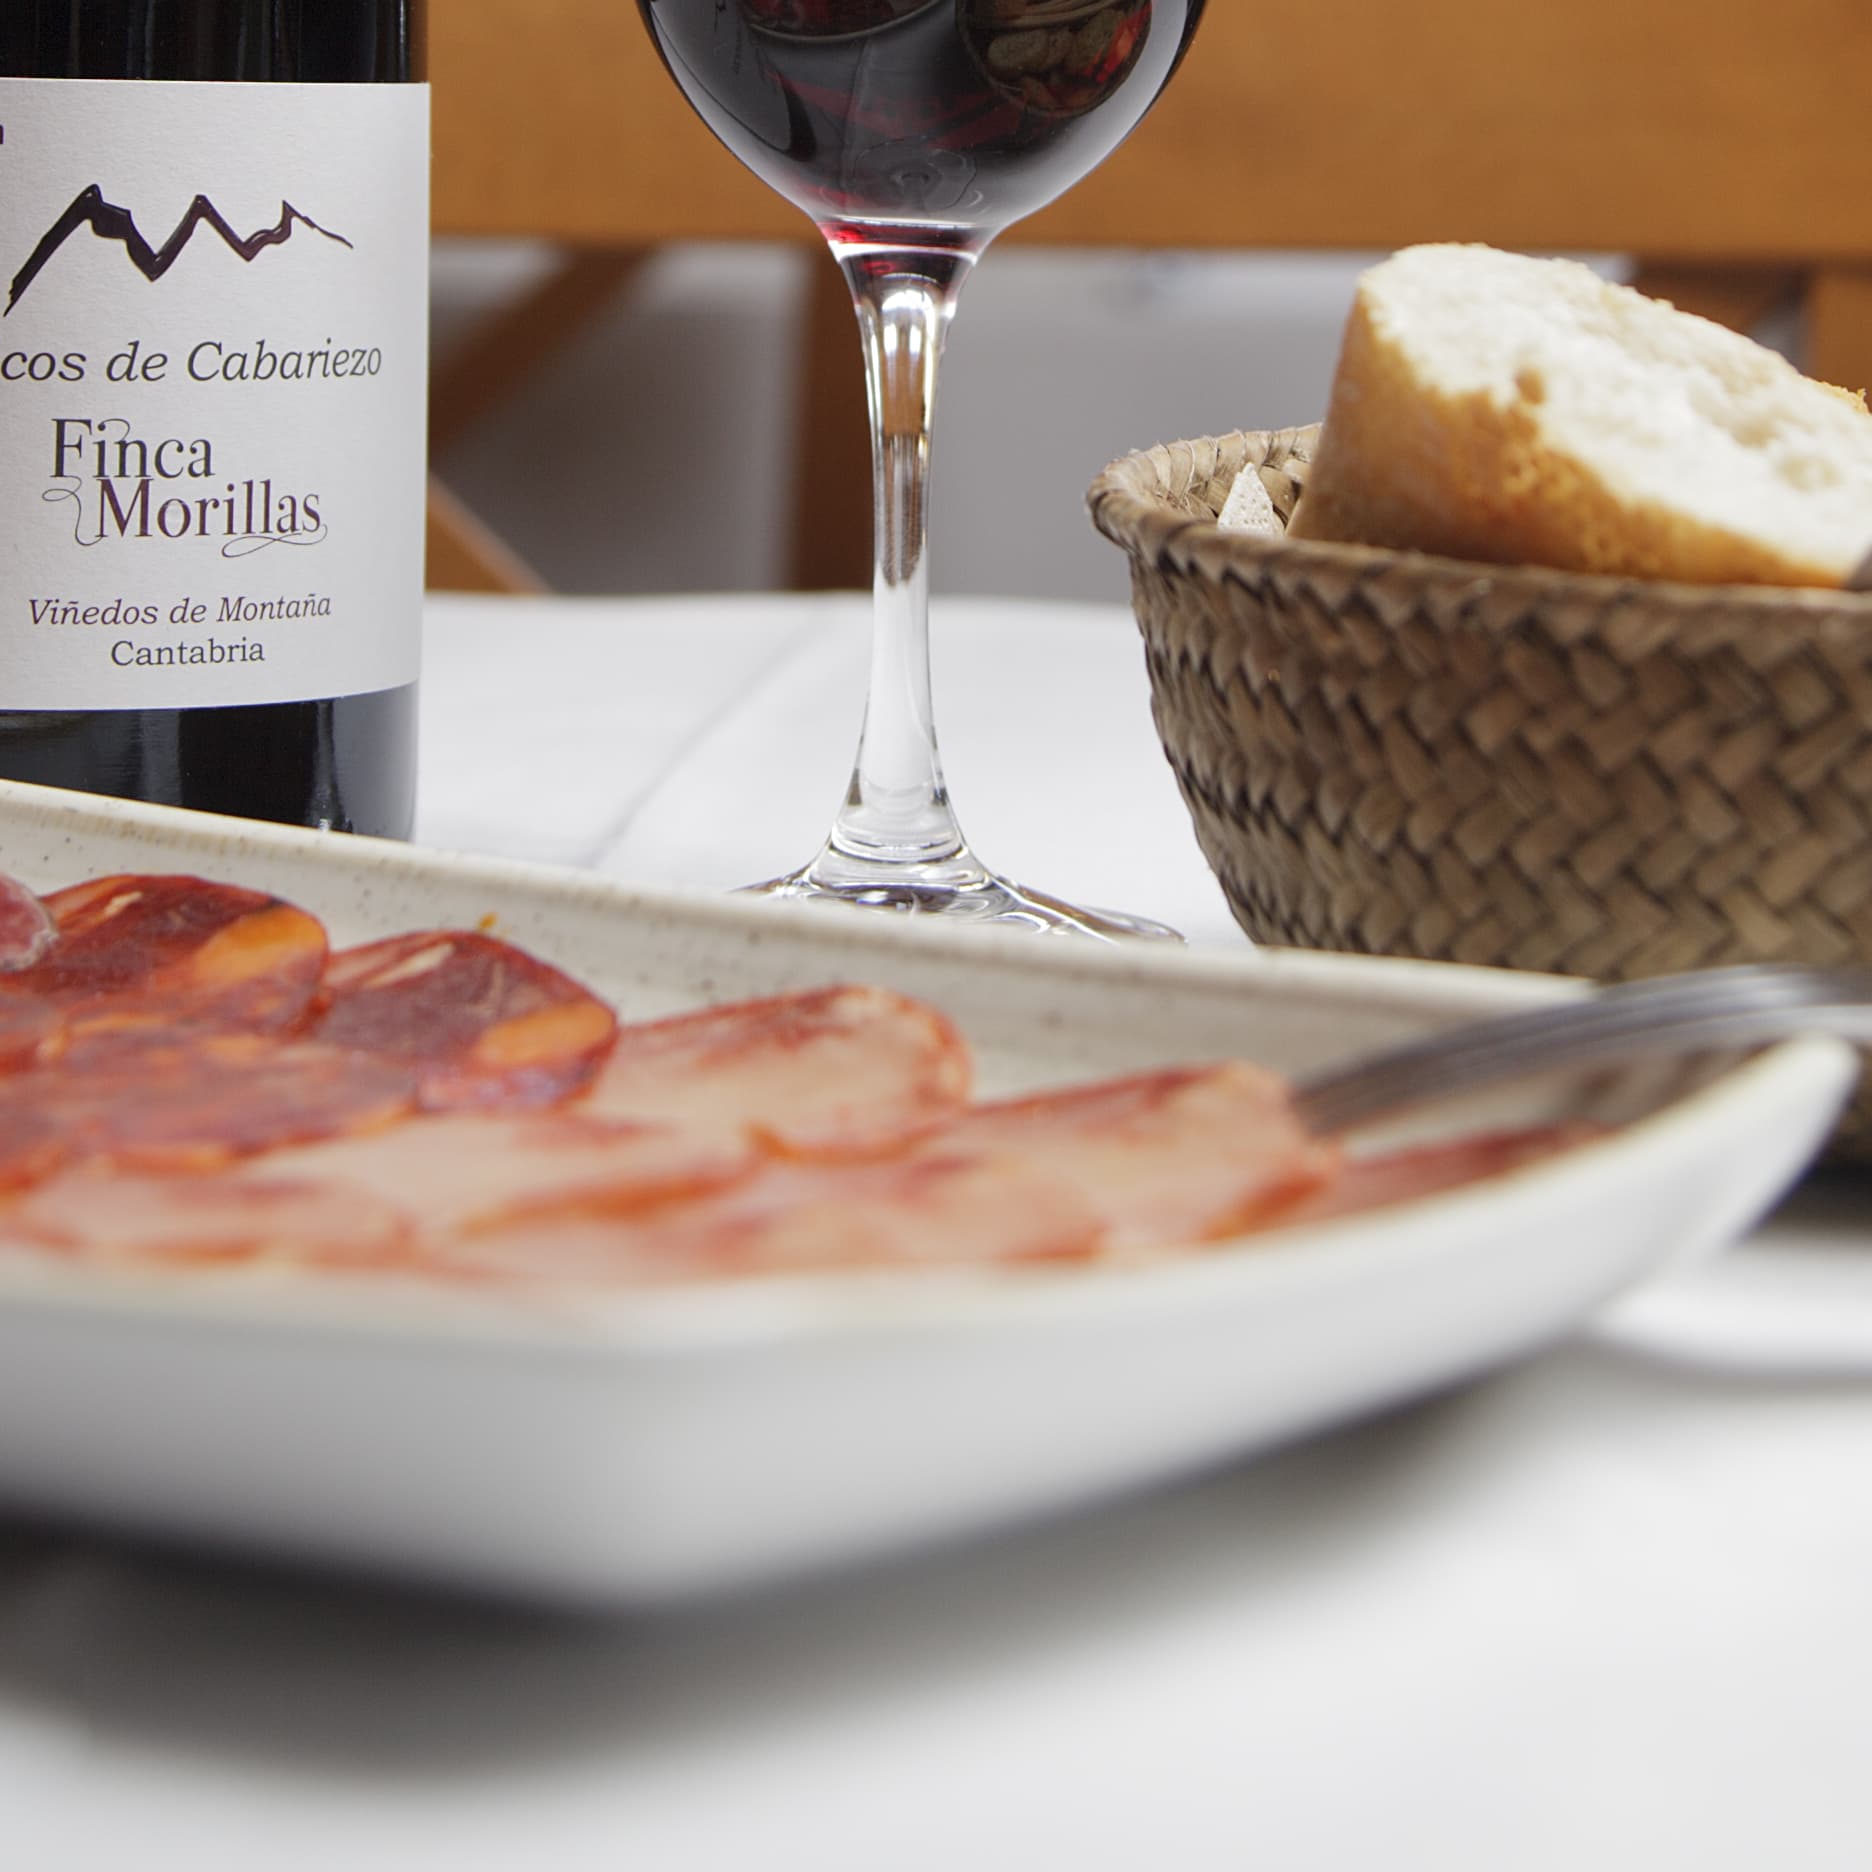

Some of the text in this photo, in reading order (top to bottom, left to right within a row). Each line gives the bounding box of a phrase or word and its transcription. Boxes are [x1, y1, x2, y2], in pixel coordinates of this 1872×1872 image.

[105, 340, 169, 383] de
[186, 336, 382, 382] Cabariezo
[48, 417, 216, 479] Finca
[93, 477, 328, 558] Morillas
[28, 592, 332, 626] Viñedos de Montaña
[110, 636, 266, 667] Cantabria
